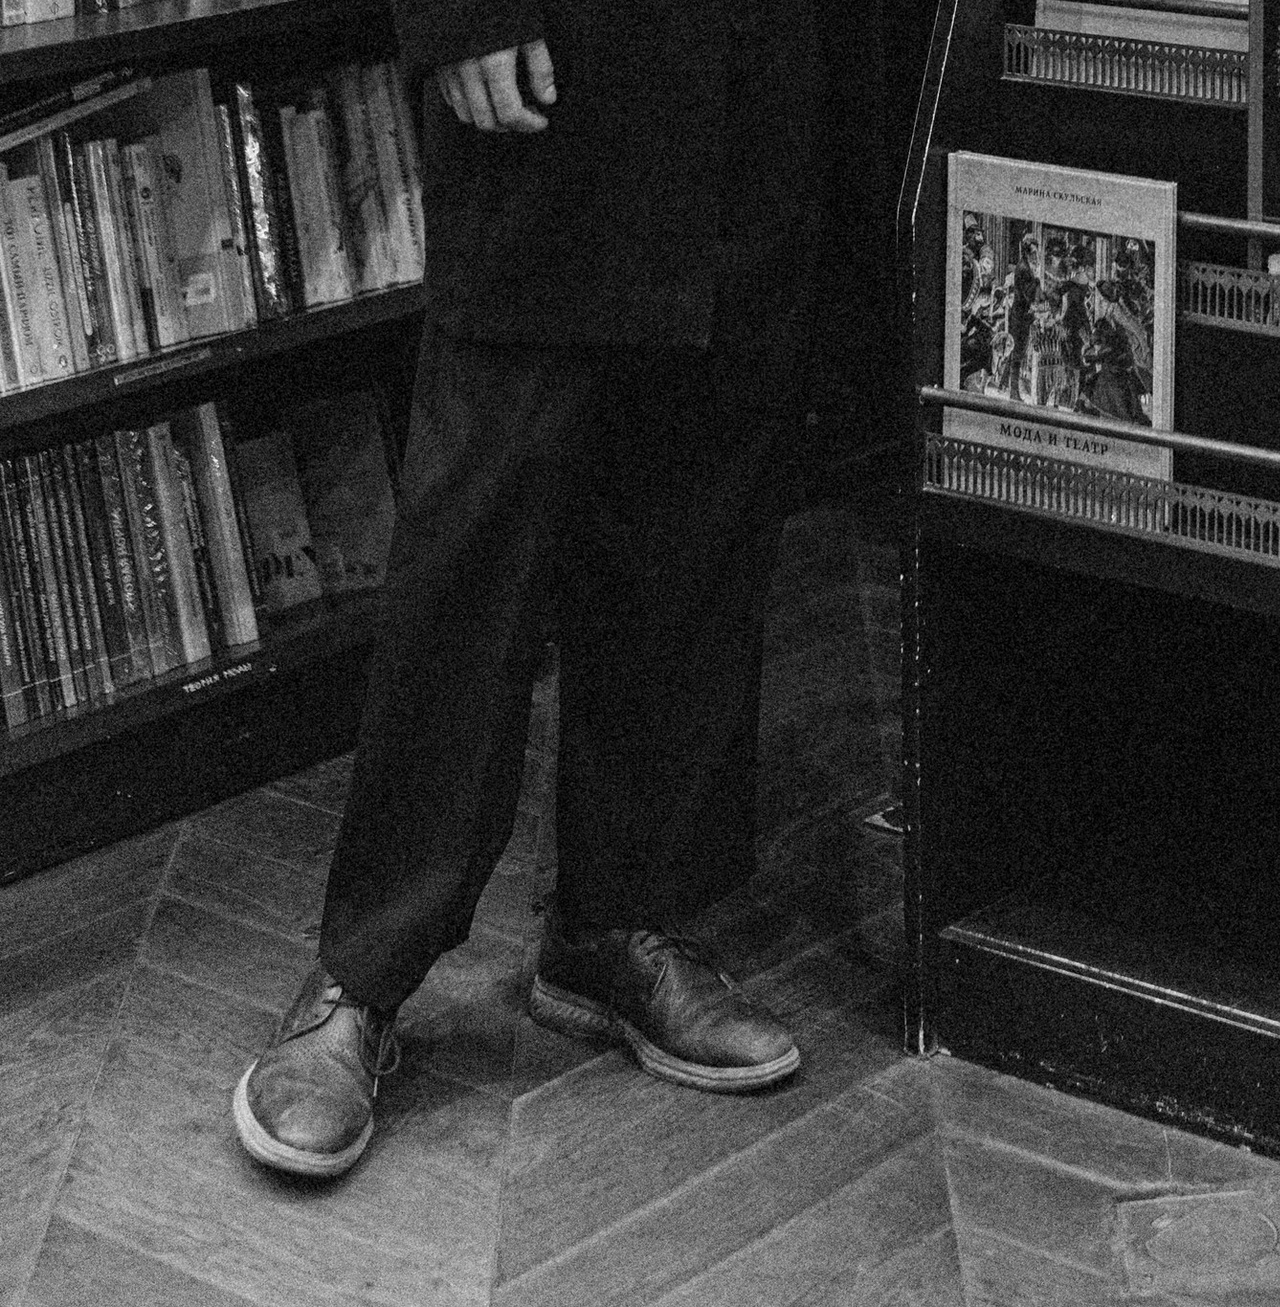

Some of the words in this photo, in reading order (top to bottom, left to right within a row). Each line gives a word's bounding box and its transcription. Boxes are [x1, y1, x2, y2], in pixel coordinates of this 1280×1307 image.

[1014, 186, 1051, 199] МАРИНА
[1053, 191, 1102, 206] СКУЛЬСКАЯ
[999, 423, 1042, 447] МОДА
[1048, 432, 1060, 448] И
[1064, 436, 1110, 457] ТЕАТР
